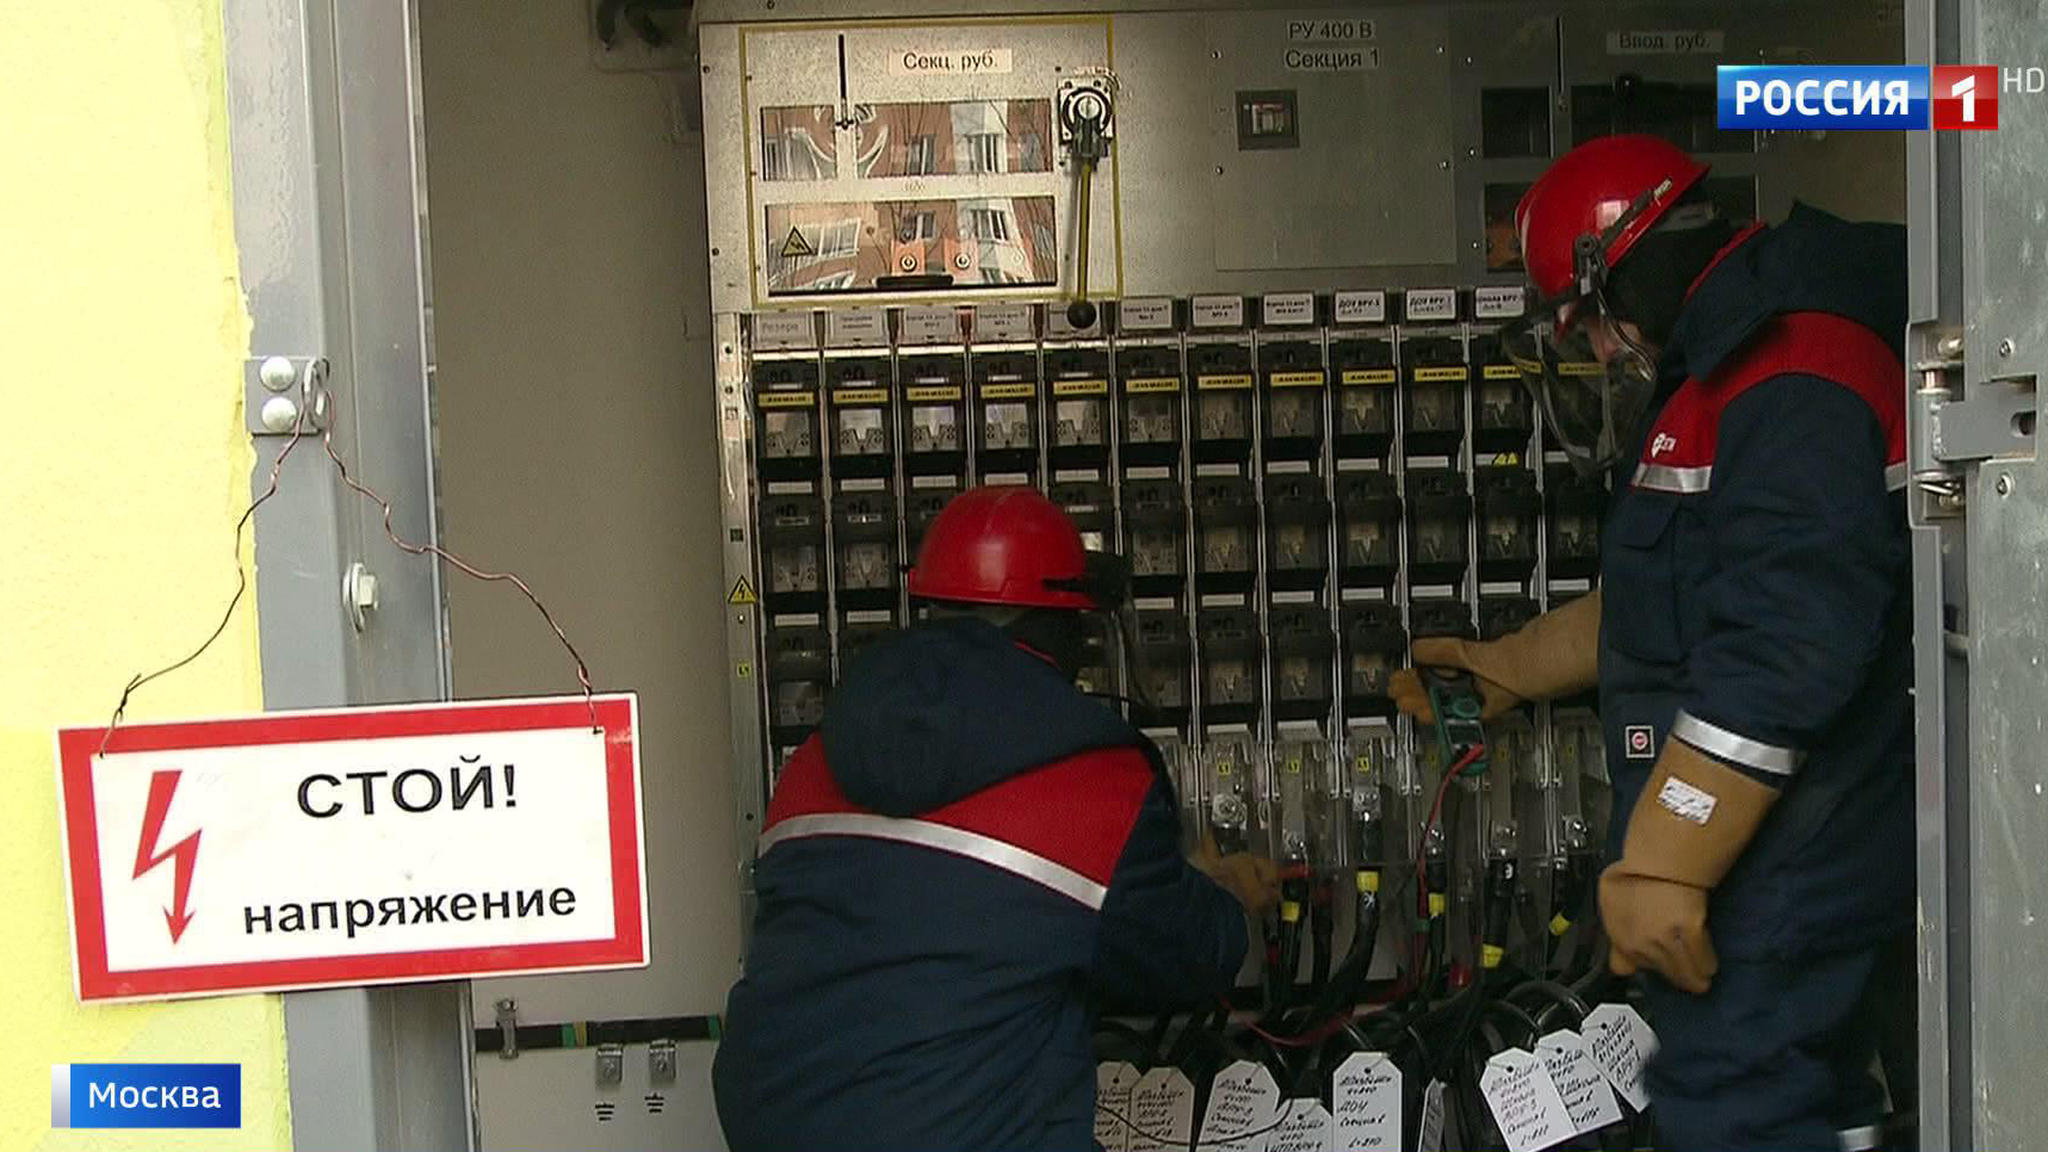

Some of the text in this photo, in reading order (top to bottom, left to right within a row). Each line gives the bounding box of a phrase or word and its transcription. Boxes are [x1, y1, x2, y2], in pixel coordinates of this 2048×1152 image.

[1289, 21, 1373, 39] РУ 400 В
[902, 50, 998, 72] Секц. руб.
[1285, 48, 1378, 72] Секция 1
[296, 754, 517, 819] СТОЙ!
[243, 886, 577, 939] напряжение
